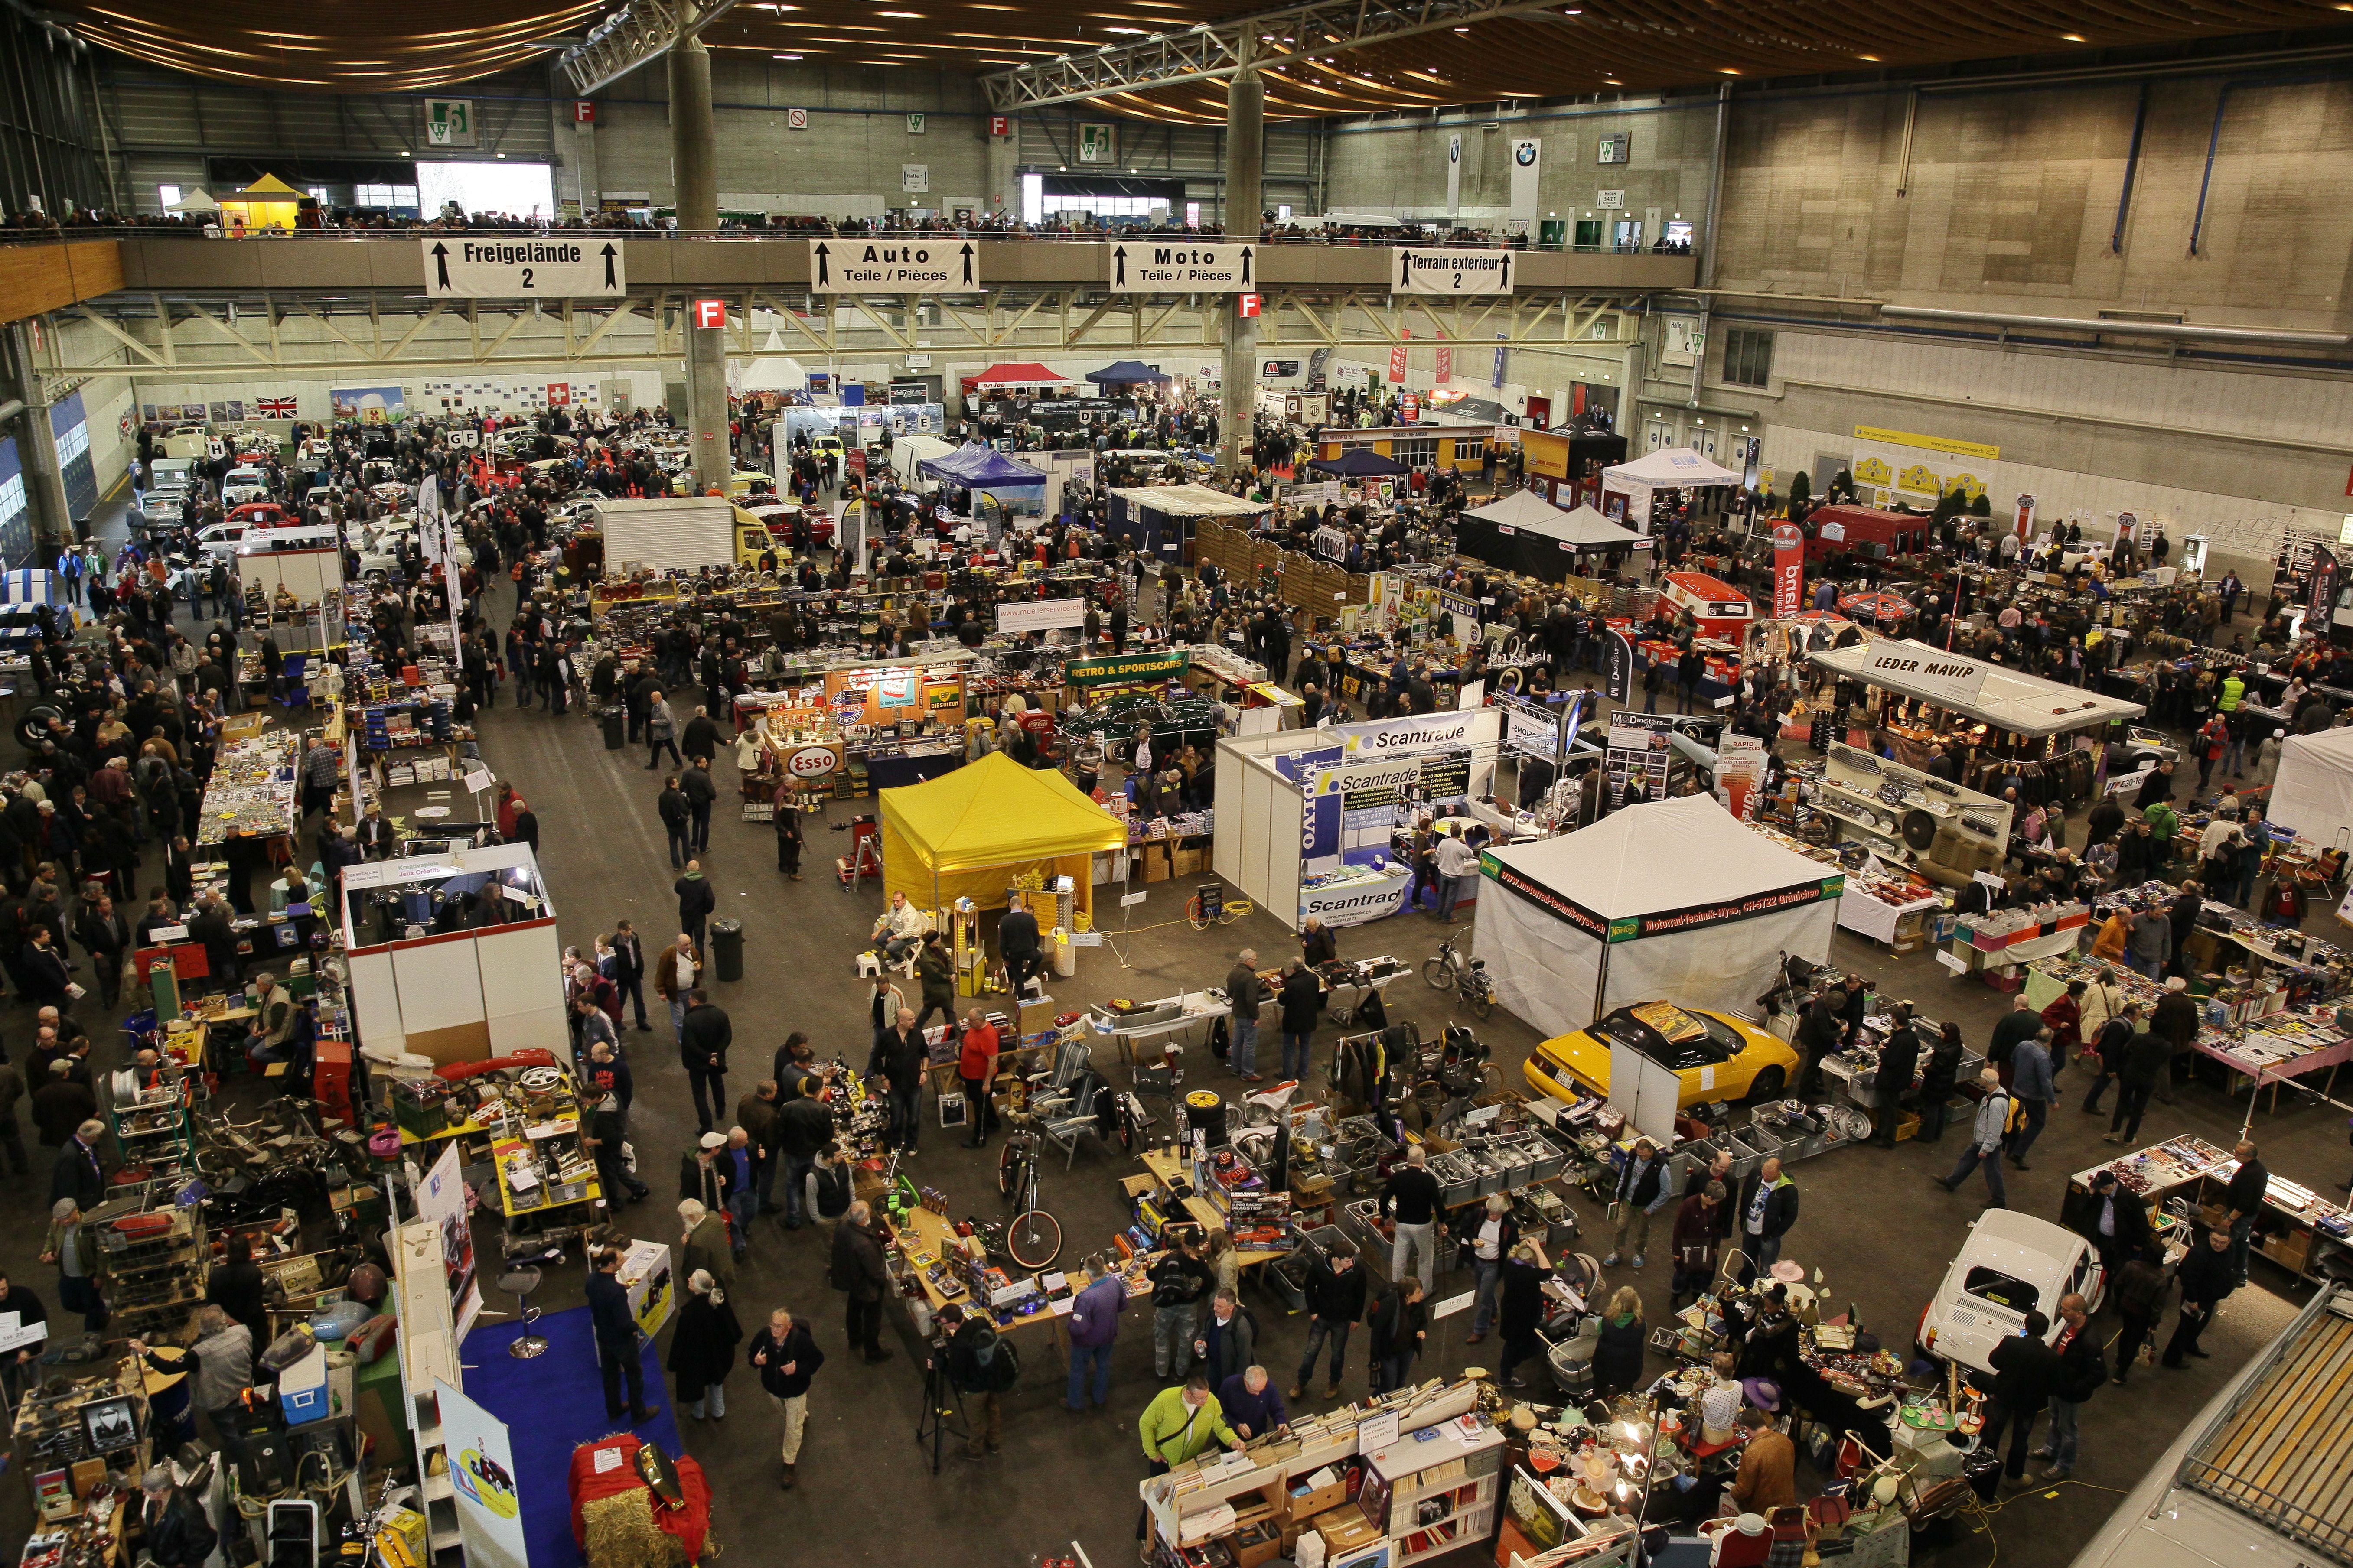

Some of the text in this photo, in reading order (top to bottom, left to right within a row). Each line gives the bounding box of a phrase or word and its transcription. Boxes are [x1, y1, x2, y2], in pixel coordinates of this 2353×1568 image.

[445, 104, 463, 132] 6
[577, 102, 590, 120] F
[993, 117, 1004, 134] F
[1093, 127, 1106, 152] 6
[464, 243, 581, 265] Freigelände
[862, 245, 929, 263] Auto
[1155, 248, 1216, 264] Moto
[1412, 254, 1499, 270] Terrain extérieur
[522, 269, 534, 288] 2
[844, 269, 881, 281] Teile
[898, 269, 948, 281] Pièces
[1140, 270, 1173, 281] Teile
[1189, 269, 1232, 281] Pièces
[1454, 273, 1461, 289] 2
[1243, 295, 1256, 316] F
[701, 302, 718, 327] F
[1685, 342, 1689, 351] C
[1310, 348, 1327, 378] EVANS
[896, 419, 902, 428] F
[921, 418, 927, 427] E
[1082, 412, 1089, 421] D
[451, 434, 460, 444] G
[464, 434, 474, 442] F
[211, 444, 221, 455] H
[1670, 455, 1698, 465] SIM
[1675, 587, 1688, 603] SONAX
[1001, 604, 1081, 617] www.muellerservice.ch
[1444, 598, 1473, 616] PNEU
[1072, 659, 1182, 677] RETRO & SPORTSCARS
[1875, 657, 1974, 678] LEDER MAVIP
[1376, 724, 1464, 748] Scantrade
[1341, 767, 1418, 791] Scantrade
[1302, 761, 1317, 849] VOLVO
[1344, 809, 1372, 818] Scantrade
[398, 861, 439, 871] Kreativspiele
[415, 867, 440, 876] Créatifs
[1481, 856, 1499, 875] Norton
[1823, 881, 1844, 895] Norton
[1501, 870, 1605, 935] www.motorrad-technik-wyss.ch
[1645, 888, 1819, 931] Motorrad-Technik-Wyss, CH-5722 Gränichen
[1325, 910, 1372, 920] www.mike-sander.ch
[1610, 924, 1637, 937] Norton
[1363, 1419, 1388, 1430] AUTOLIVRE
